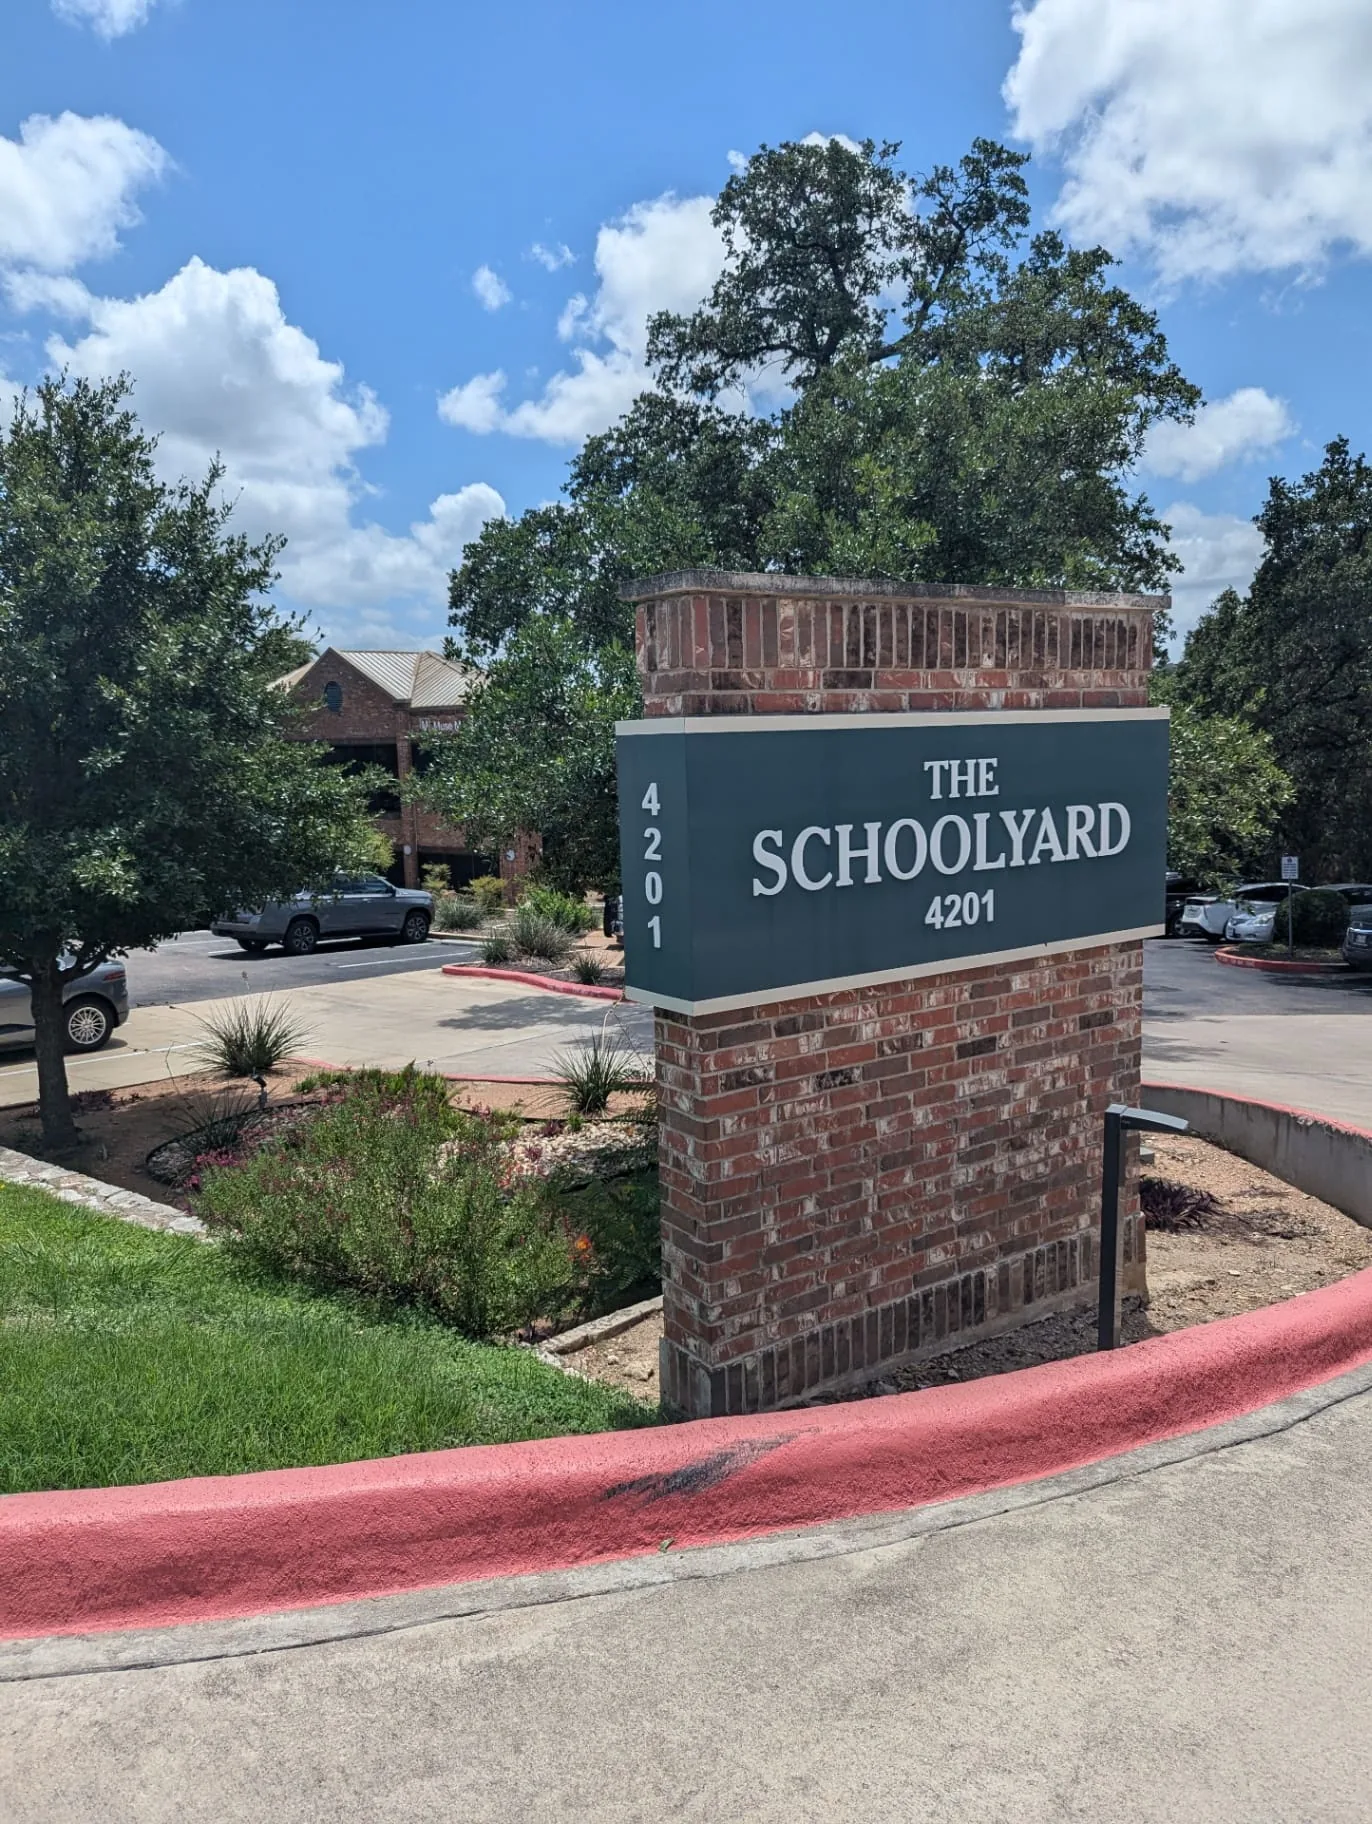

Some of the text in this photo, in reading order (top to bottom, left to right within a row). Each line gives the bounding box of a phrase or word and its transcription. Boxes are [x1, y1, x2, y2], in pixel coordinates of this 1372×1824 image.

[924, 758, 999, 800] THE
[642, 783, 662, 948] 4201
[753, 803, 1130, 896] SCHOOLYARD
[925, 889, 993, 929] 4201
